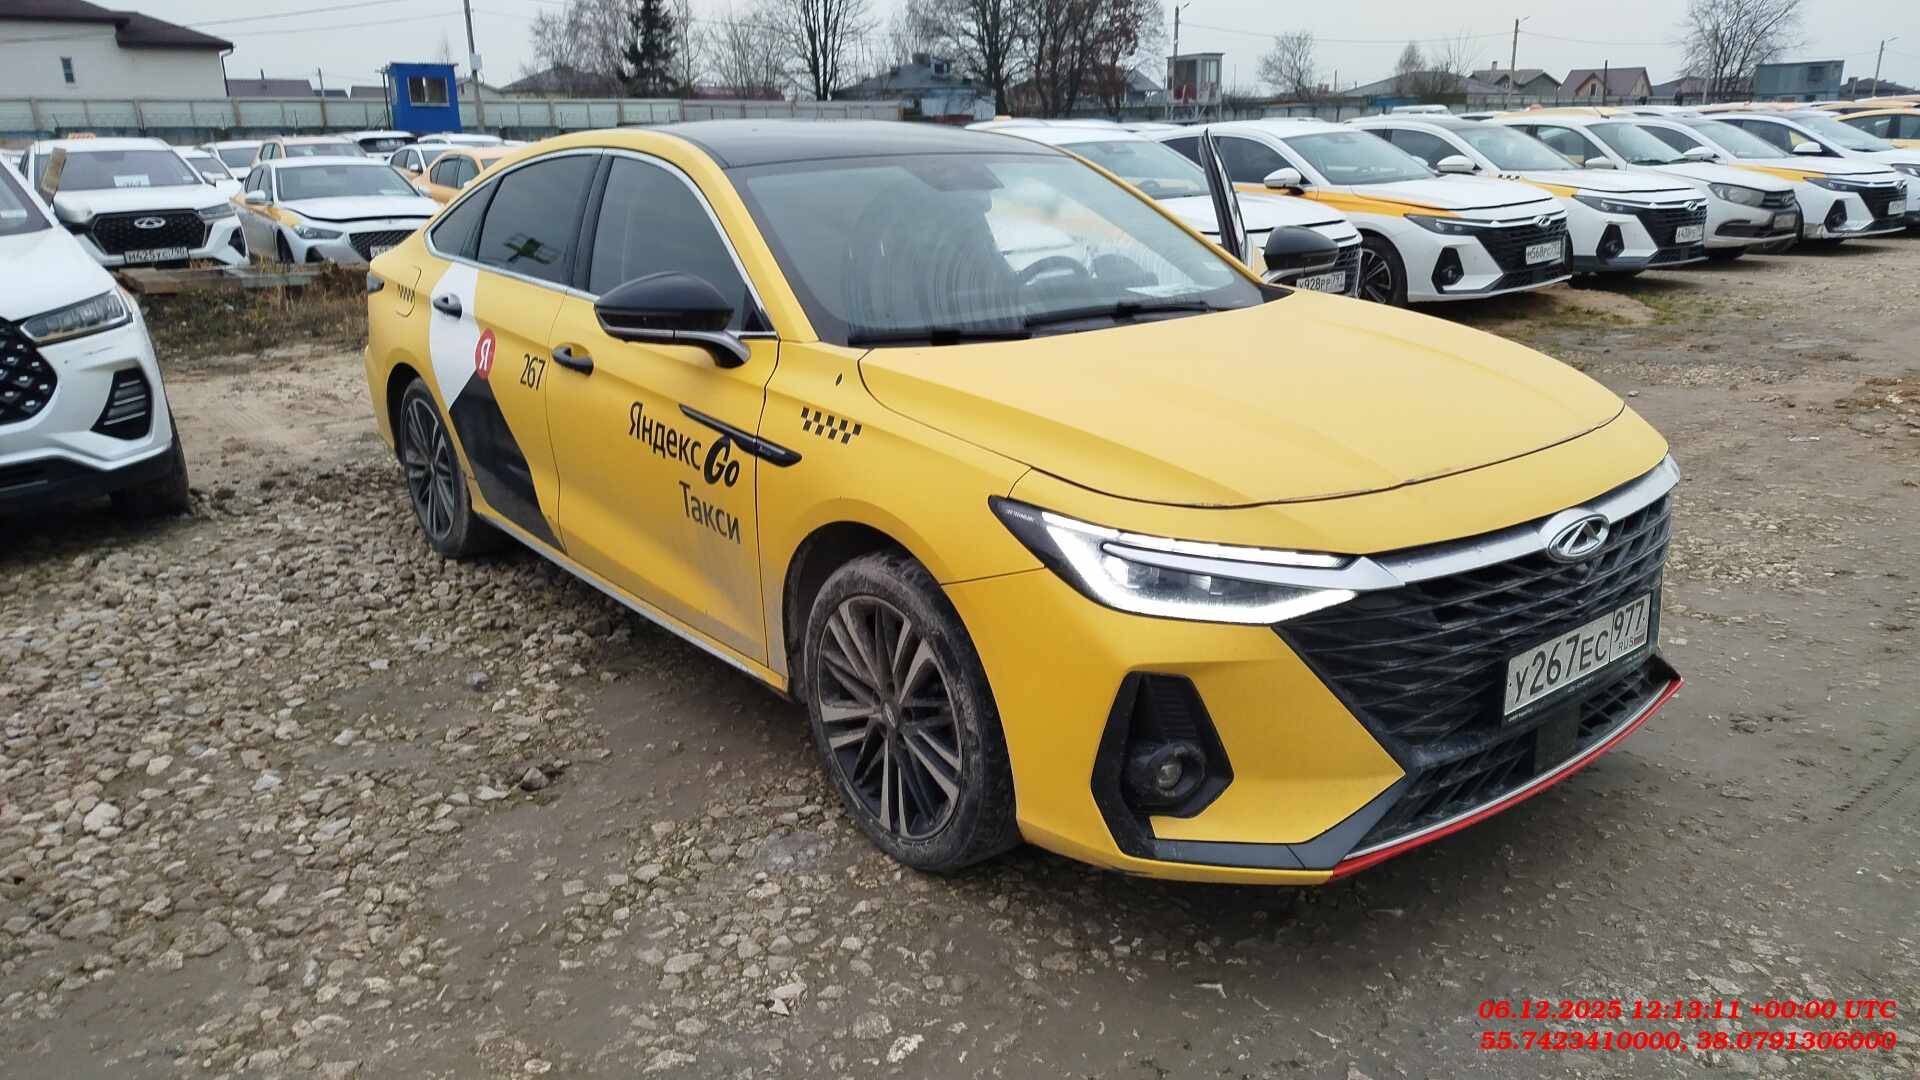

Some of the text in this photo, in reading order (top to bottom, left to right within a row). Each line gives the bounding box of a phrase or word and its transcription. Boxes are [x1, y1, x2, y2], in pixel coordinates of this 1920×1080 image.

[479, 339, 491, 371] Я
[520, 353, 546, 391] 267
[629, 401, 740, 487] Яндекс Go
[679, 480, 741, 545] Такси
[1514, 600, 1645, 704] У267ЕС 977
[1618, 637, 1634, 651] RUS
